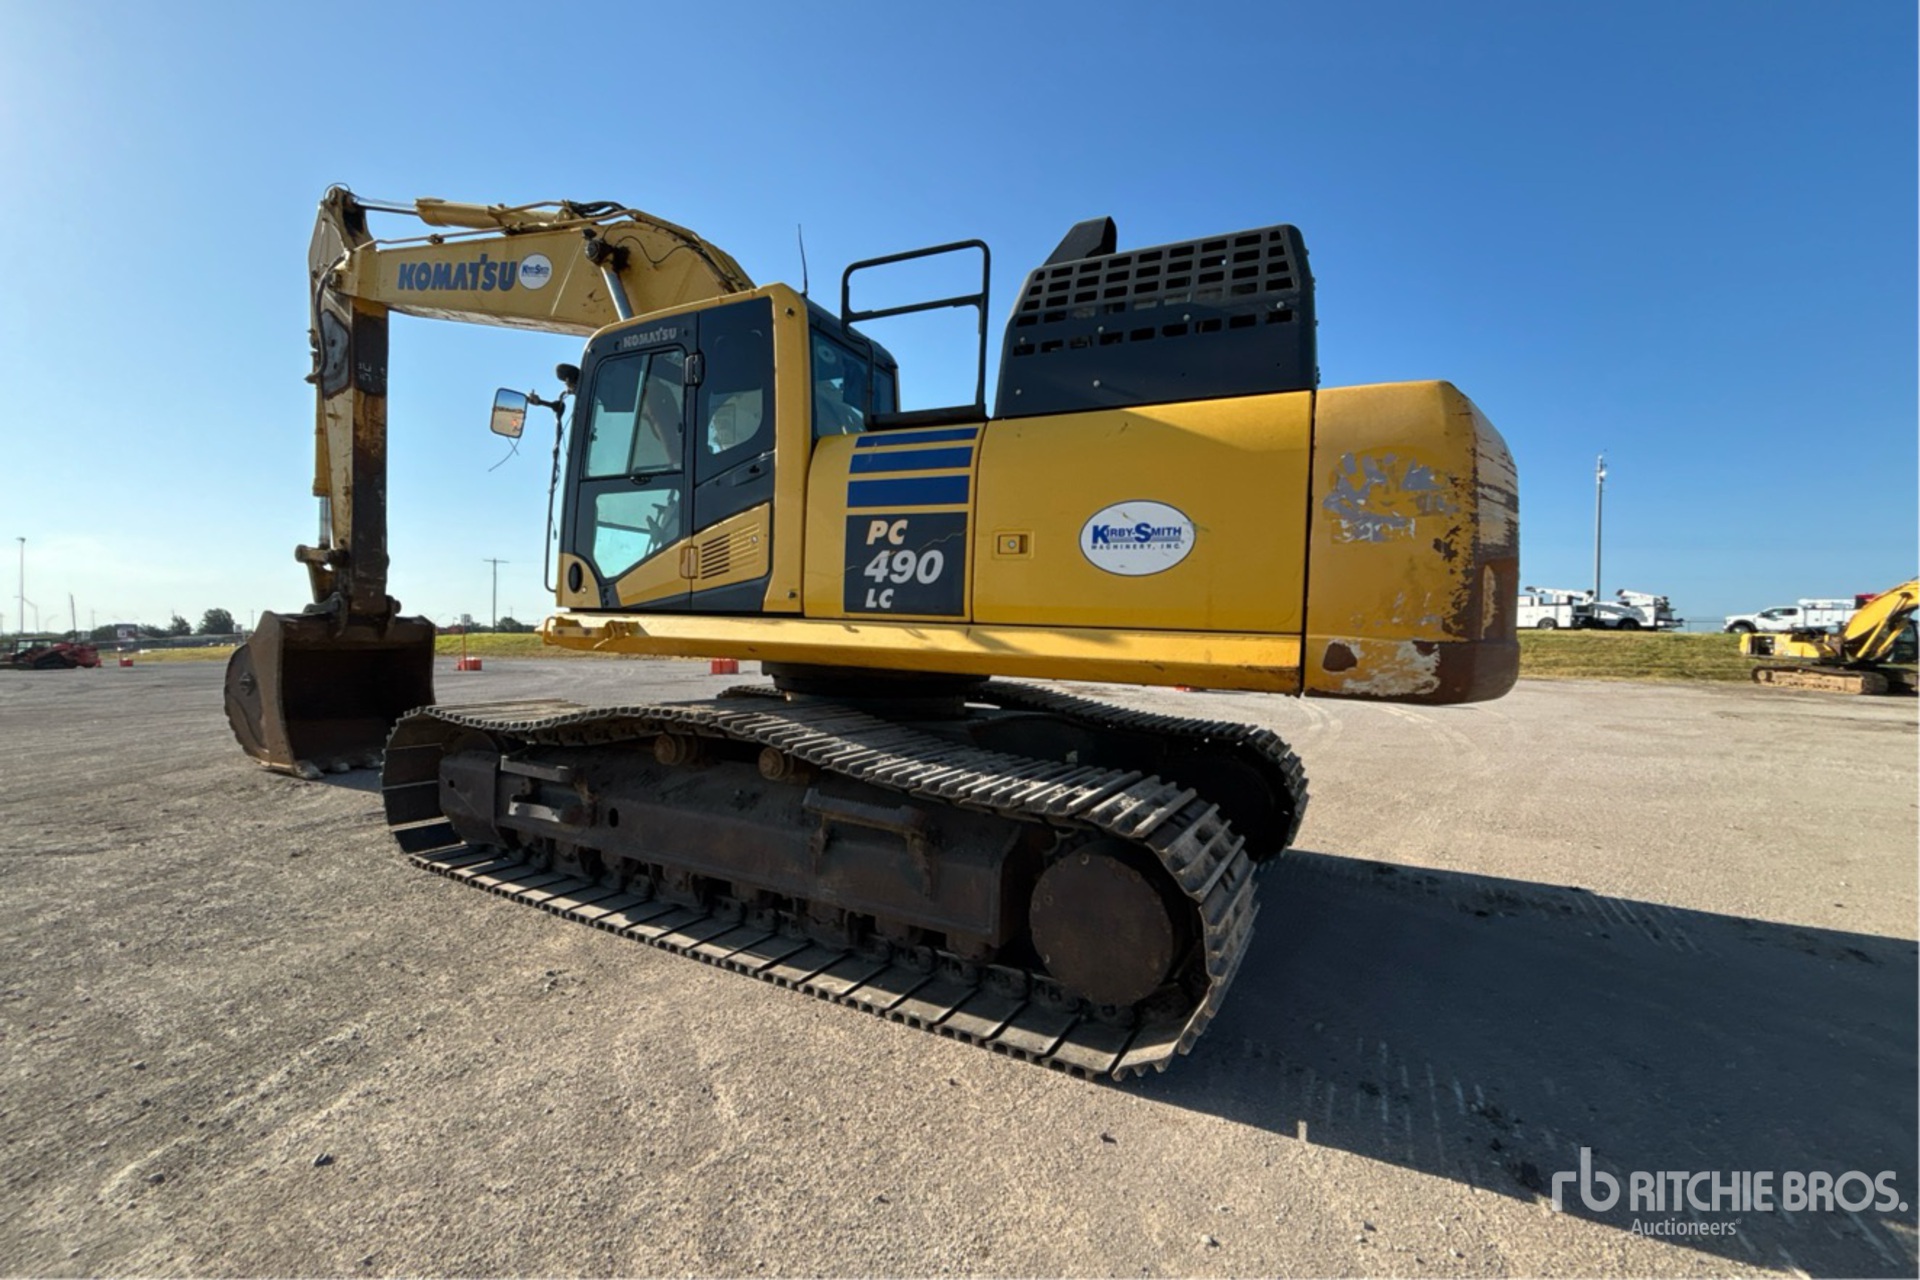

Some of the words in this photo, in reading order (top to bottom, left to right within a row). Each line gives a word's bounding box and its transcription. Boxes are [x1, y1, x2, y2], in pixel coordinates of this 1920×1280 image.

[398, 254, 517, 291] KOMATSU
[623, 326, 677, 348] KOMATSU
[866, 519, 908, 545] PC
[1092, 522, 1182, 545] KIRBY-SMITH
[864, 549, 944, 585] 490
[865, 588, 894, 609] LC
